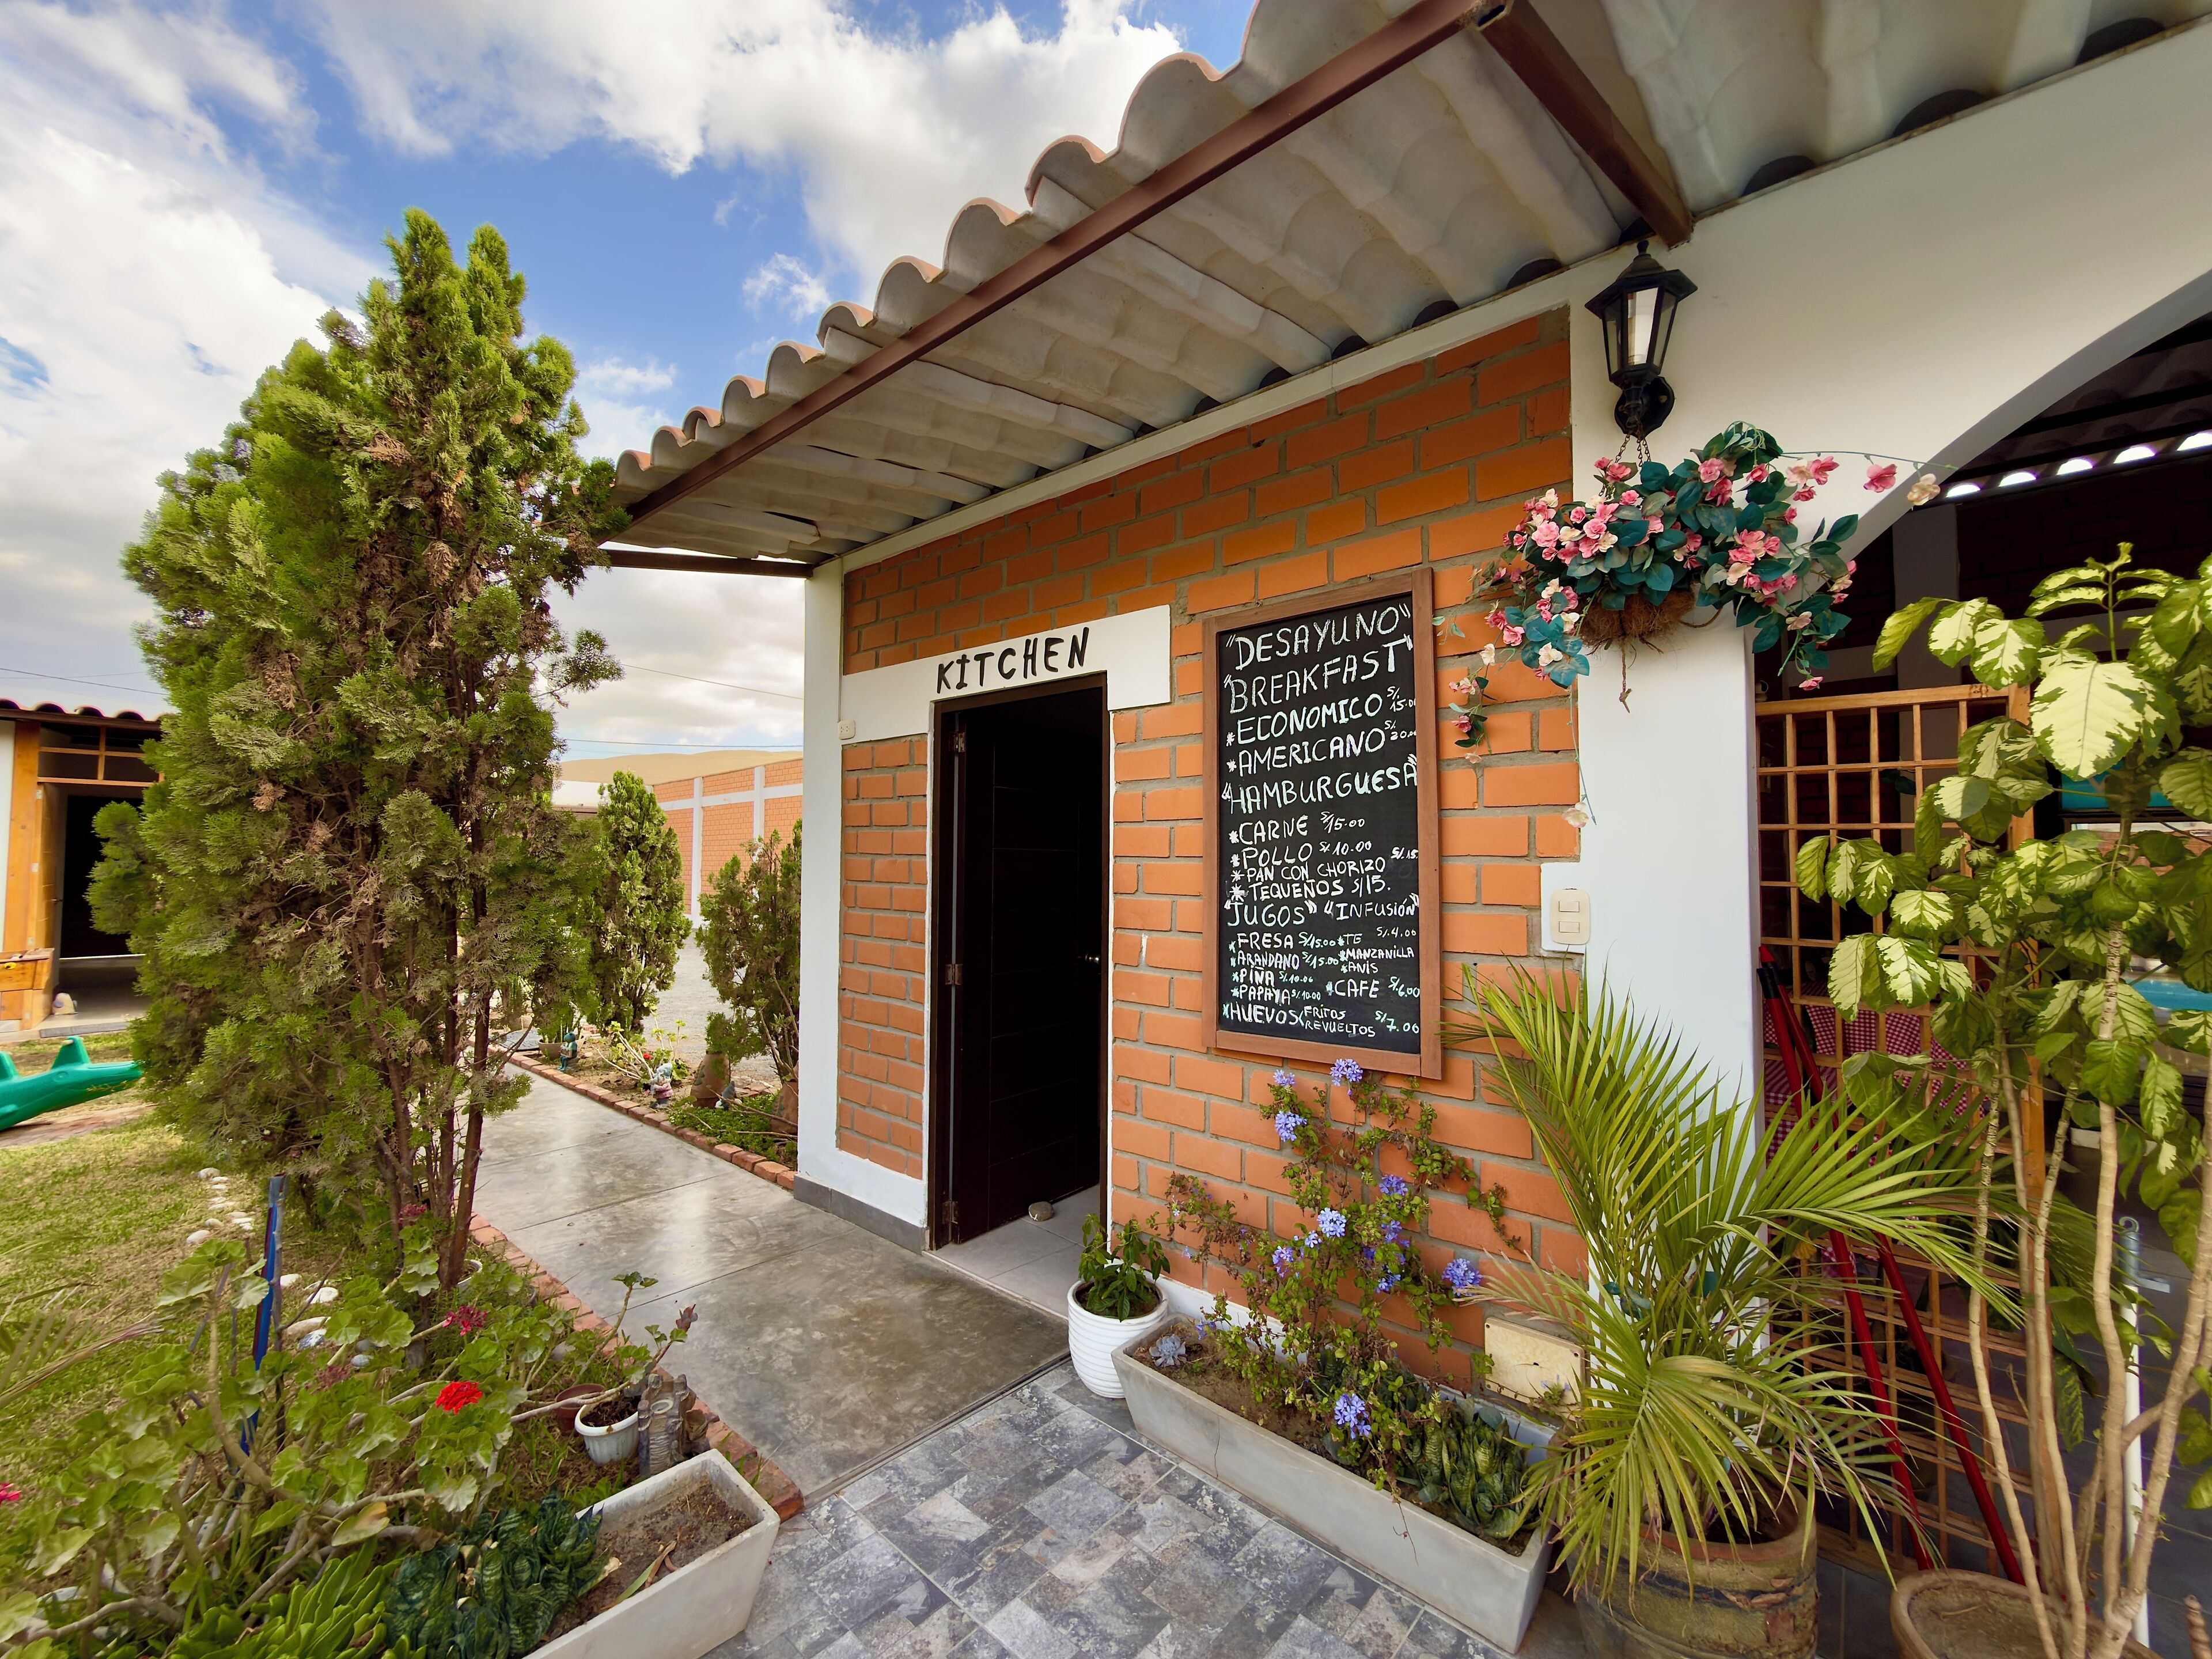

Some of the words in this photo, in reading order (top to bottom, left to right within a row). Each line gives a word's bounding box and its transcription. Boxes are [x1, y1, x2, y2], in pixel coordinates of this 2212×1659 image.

[937, 627, 1089, 694] KITCHEN
[1237, 694, 1382, 744] ECONOMICO
[1239, 728, 1385, 777] AMERICANO
[1239, 815, 1308, 845] CARNE
[1241, 842, 1313, 869] POLLO
[1247, 865, 1274, 882] PAN
[1281, 861, 1308, 880] CON
[1317, 857, 1385, 877] CHORIZO
[1237, 931, 1294, 950] FRESA
[1343, 933, 1363, 945] TE
[1237, 950, 1300, 970] ARANDANO
[1346, 945, 1414, 960] MANZANILLA
[1239, 984, 1291, 1006] PAPAYA
[1335, 979, 1380, 998] CAFE
[1230, 1001, 1299, 1025] HUEVOS
[1304, 1004, 1346, 1020] FRITOS
[1305, 1020, 1376, 1037] REVUELTOS
